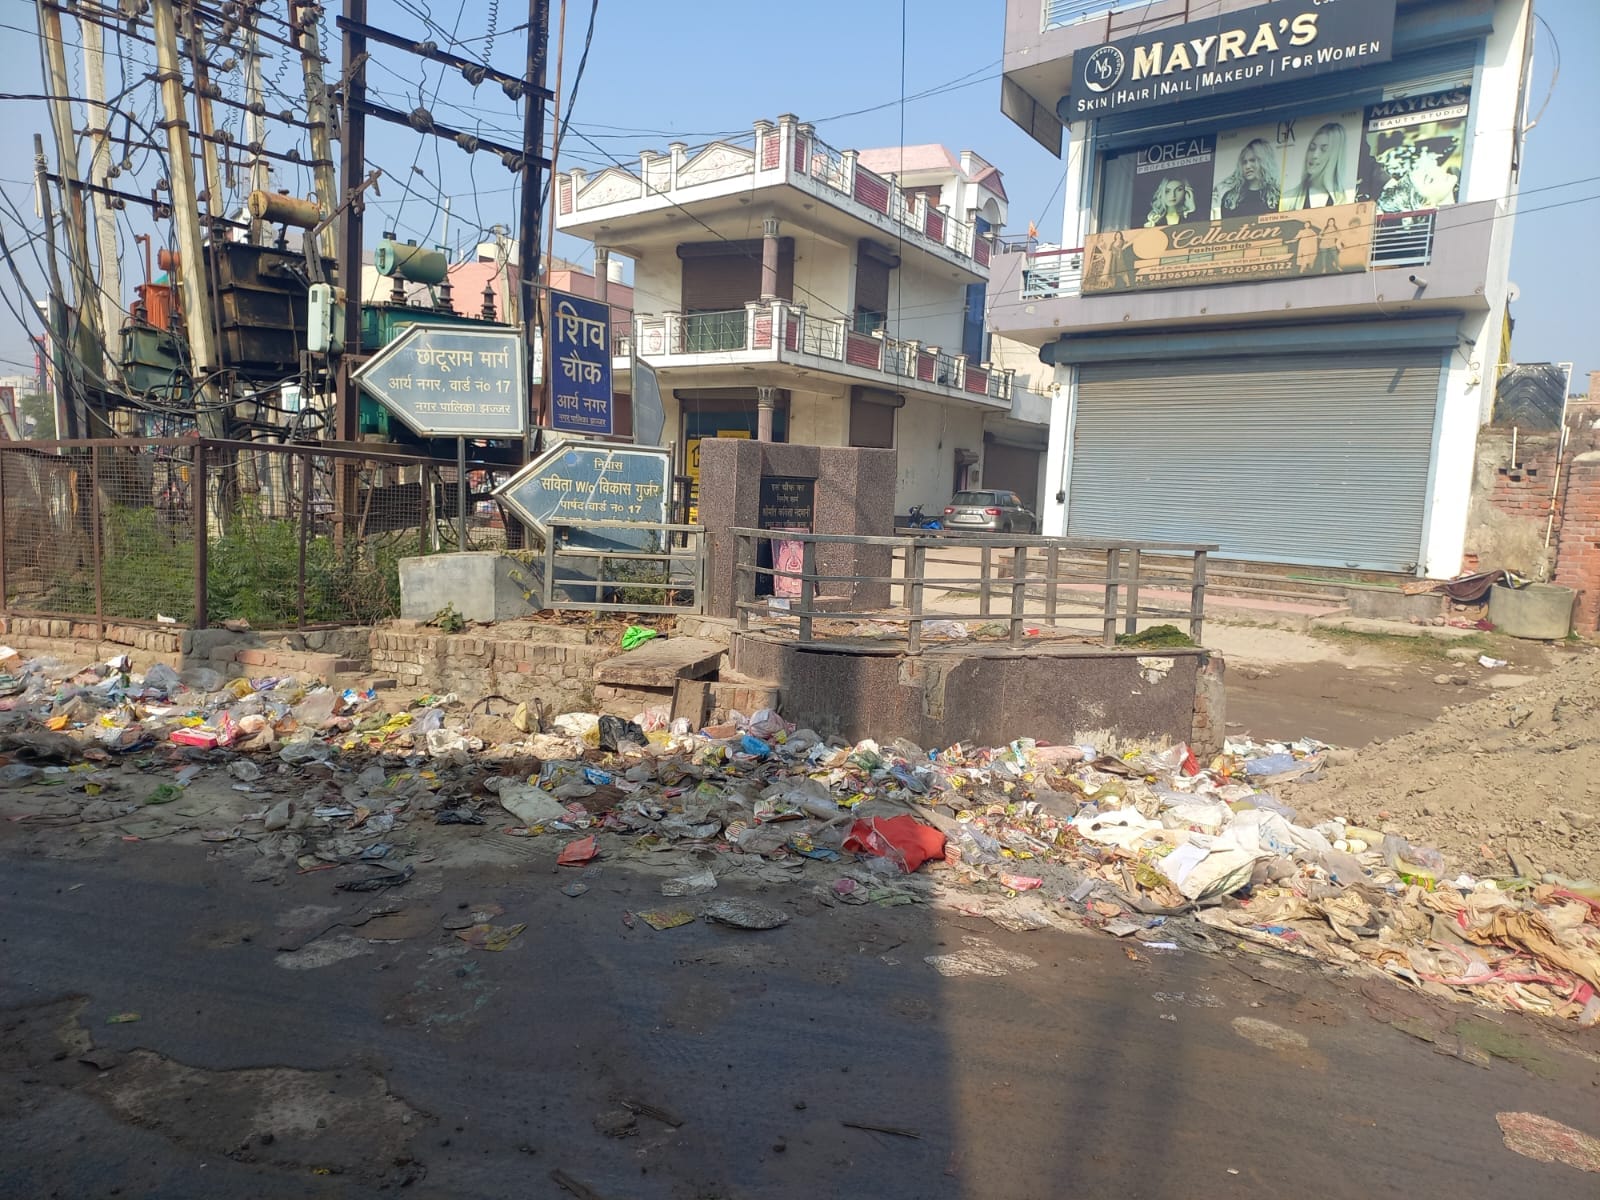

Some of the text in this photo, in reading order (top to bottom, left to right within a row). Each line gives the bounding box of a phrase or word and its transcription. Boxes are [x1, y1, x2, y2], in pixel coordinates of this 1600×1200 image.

[1131, 13, 1319, 81] MAYRA'S
[1077, 97, 1108, 112] SKIN
[1117, 88, 1149, 104] HAIR
[1160, 81, 1192, 95] NAIL
[1202, 65, 1264, 87] MAKEUP
[1317, 41, 1380, 63] WOMEN
[1172, 222, 1281, 249] Collection
[1189, 242, 1252, 254] Fashion Hub
[555, 301, 606, 350] शिव
[416, 343, 474, 372] छोटूराम
[478, 345, 509, 369] मार्ग
[560, 349, 602, 384] चौक
[388, 374, 412, 390] आर्य
[448, 375, 471, 392] वार्ड
[495, 380, 511, 393] 17
[415, 401, 437, 412] नगर
[439, 400, 475, 413] पालिका
[556, 392, 607, 414] आर्य नगर
[540, 473, 572, 492] सविता
[599, 477, 632, 496] विकास
[634, 480, 661, 502] गुर्जर
[560, 497, 585, 511] पार्षद
[588, 500, 607, 511] वार्ड
[628, 504, 642, 514] 17
